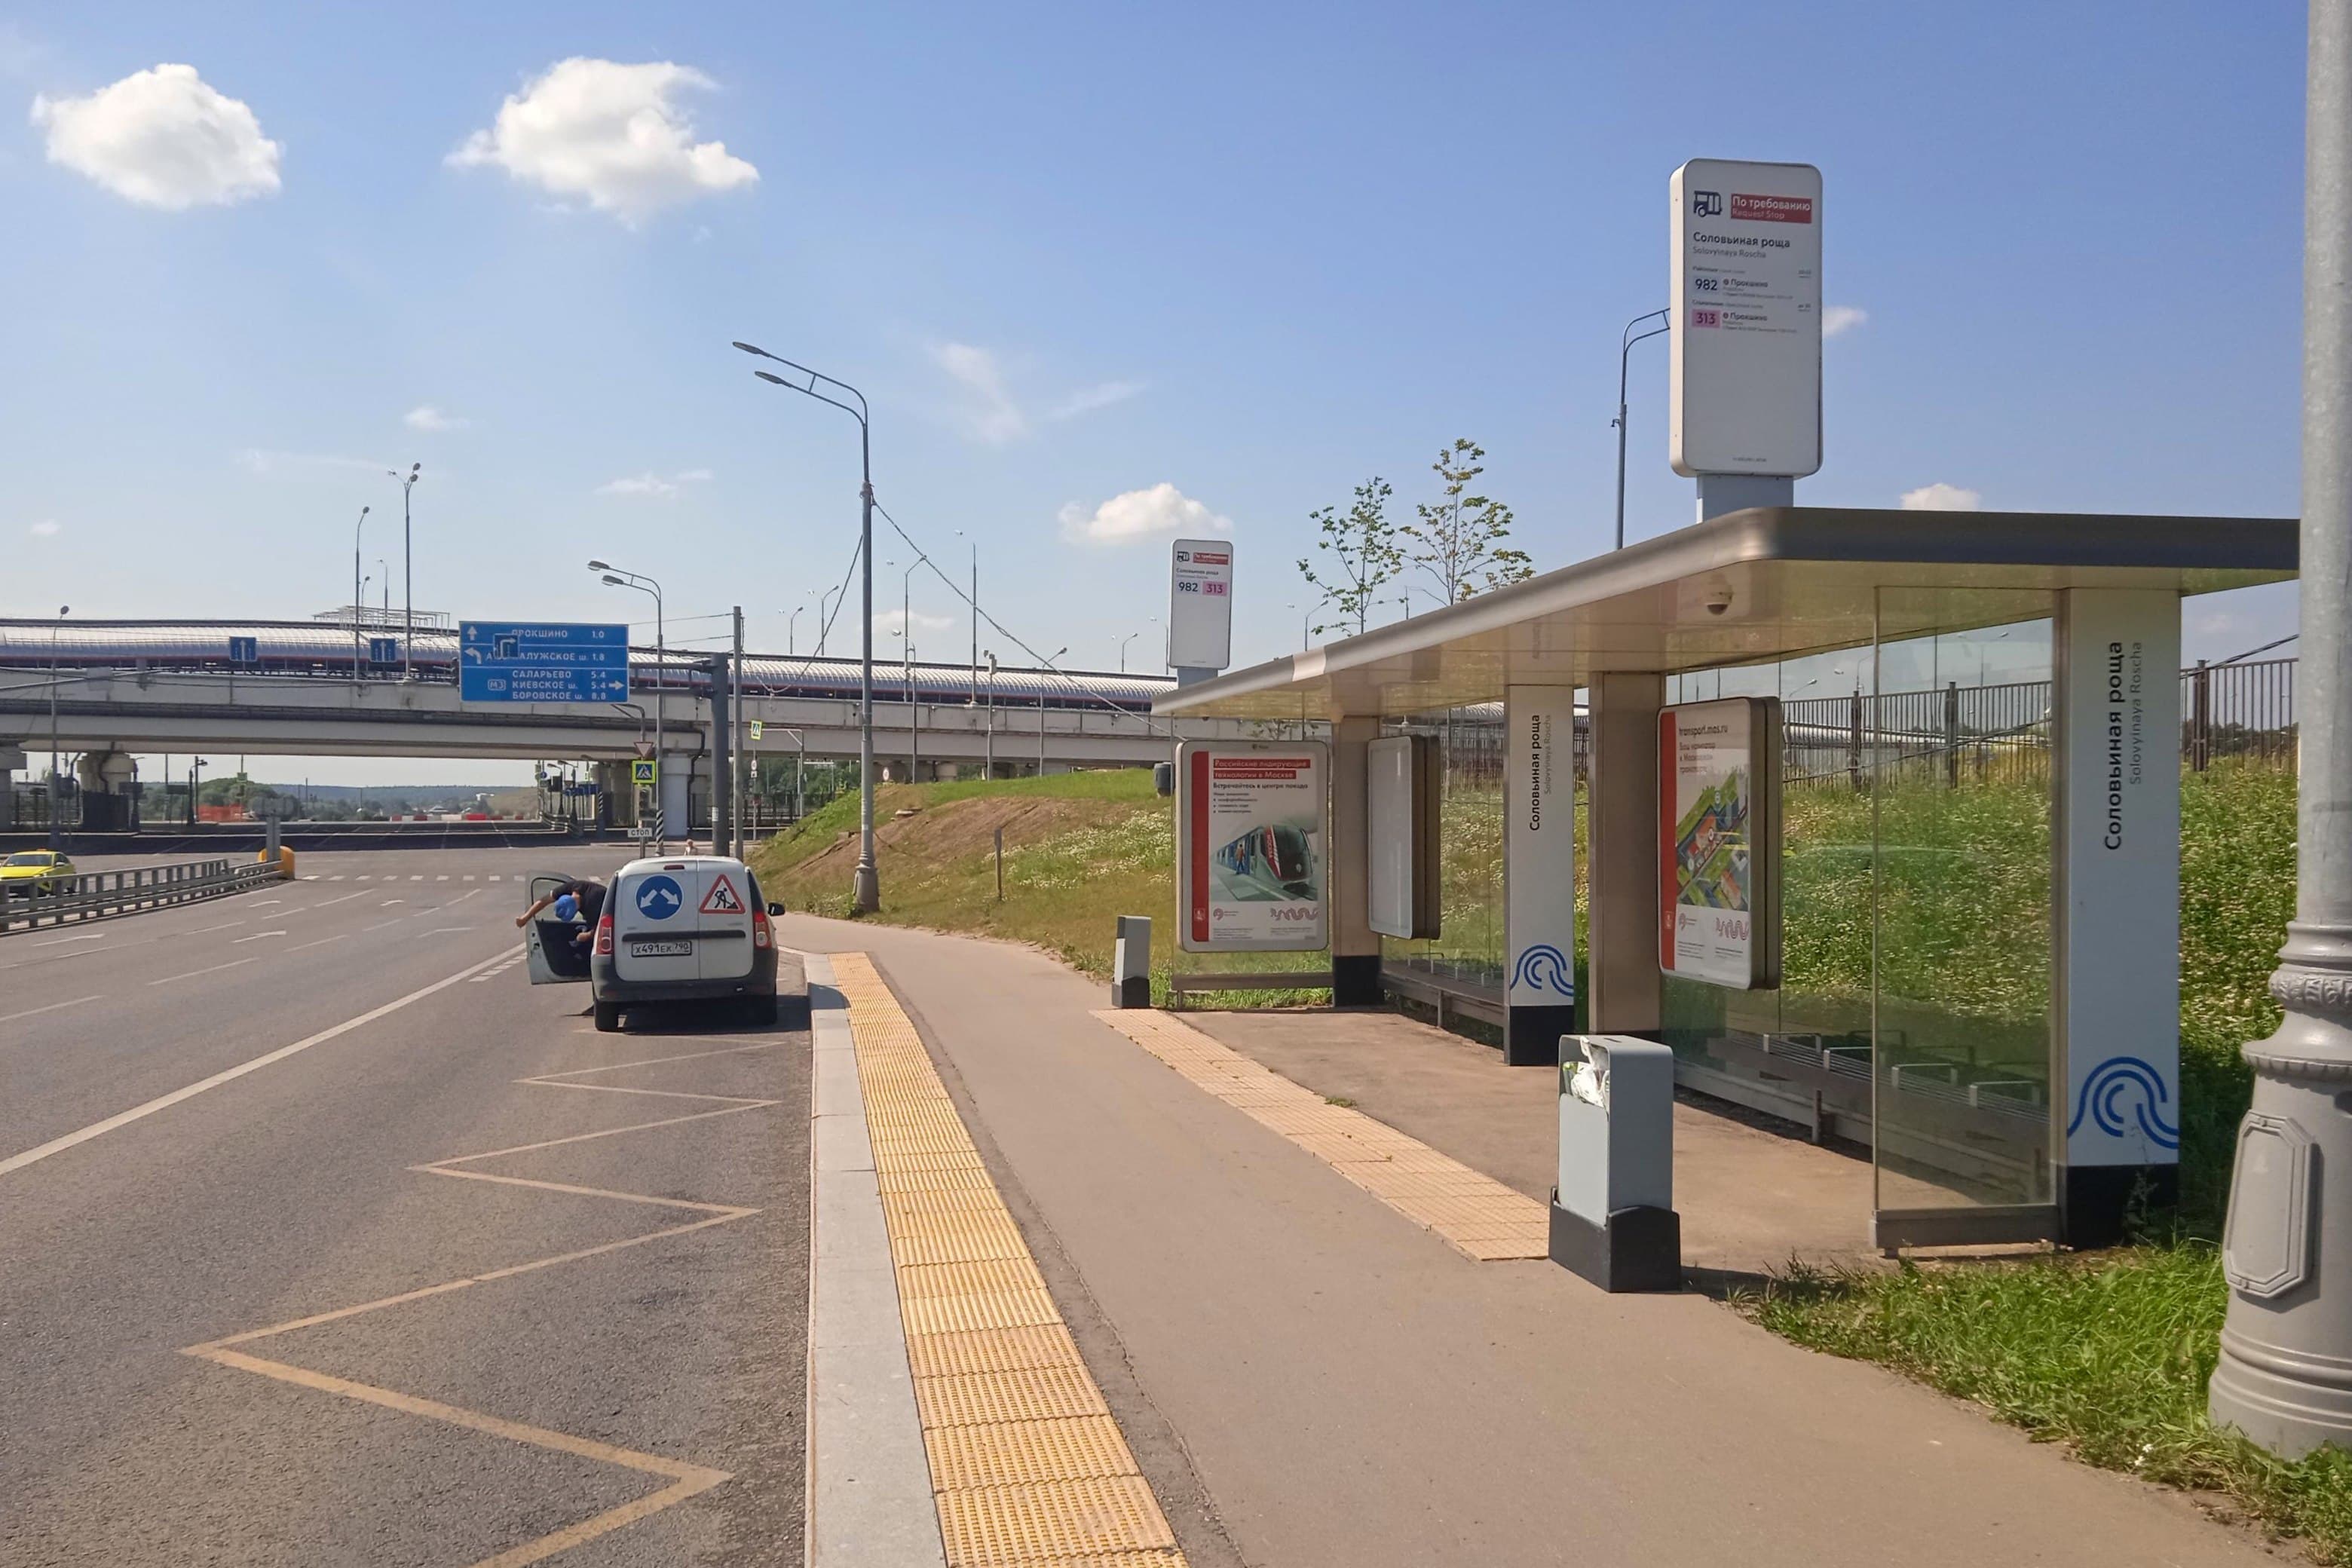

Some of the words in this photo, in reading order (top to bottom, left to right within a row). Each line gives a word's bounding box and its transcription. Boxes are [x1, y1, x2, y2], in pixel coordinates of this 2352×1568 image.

[1732, 195, 1747, 207] По
[1749, 197, 1811, 211] требованию
[1732, 207, 1765, 218] Request
[1766, 210, 1785, 219] Stop
[1693, 231, 1759, 246] Соловьиная
[1761, 238, 1790, 249] роща
[1738, 250, 1766, 258] Roscha
[1695, 278, 1718, 291] 982
[1696, 312, 1716, 324] 313
[1178, 581, 1199, 593] 982
[1206, 583, 1223, 594] 313
[519, 652, 575, 660] АЛУЖСКОЕ
[513, 670, 572, 678] САЛАРЬЕВО
[2109, 642, 2125, 703] роща
[2130, 642, 2142, 694] Roscha
[513, 681, 565, 689] КИЕВСКОЕ
[513, 691, 572, 700] БОРОВСКОЕ
[1531, 715, 1542, 749] роща
[2129, 699, 2144, 785] Solovyinaya
[2104, 711, 2122, 850] Соловьиная
[1530, 753, 1540, 831] Соловьиная
